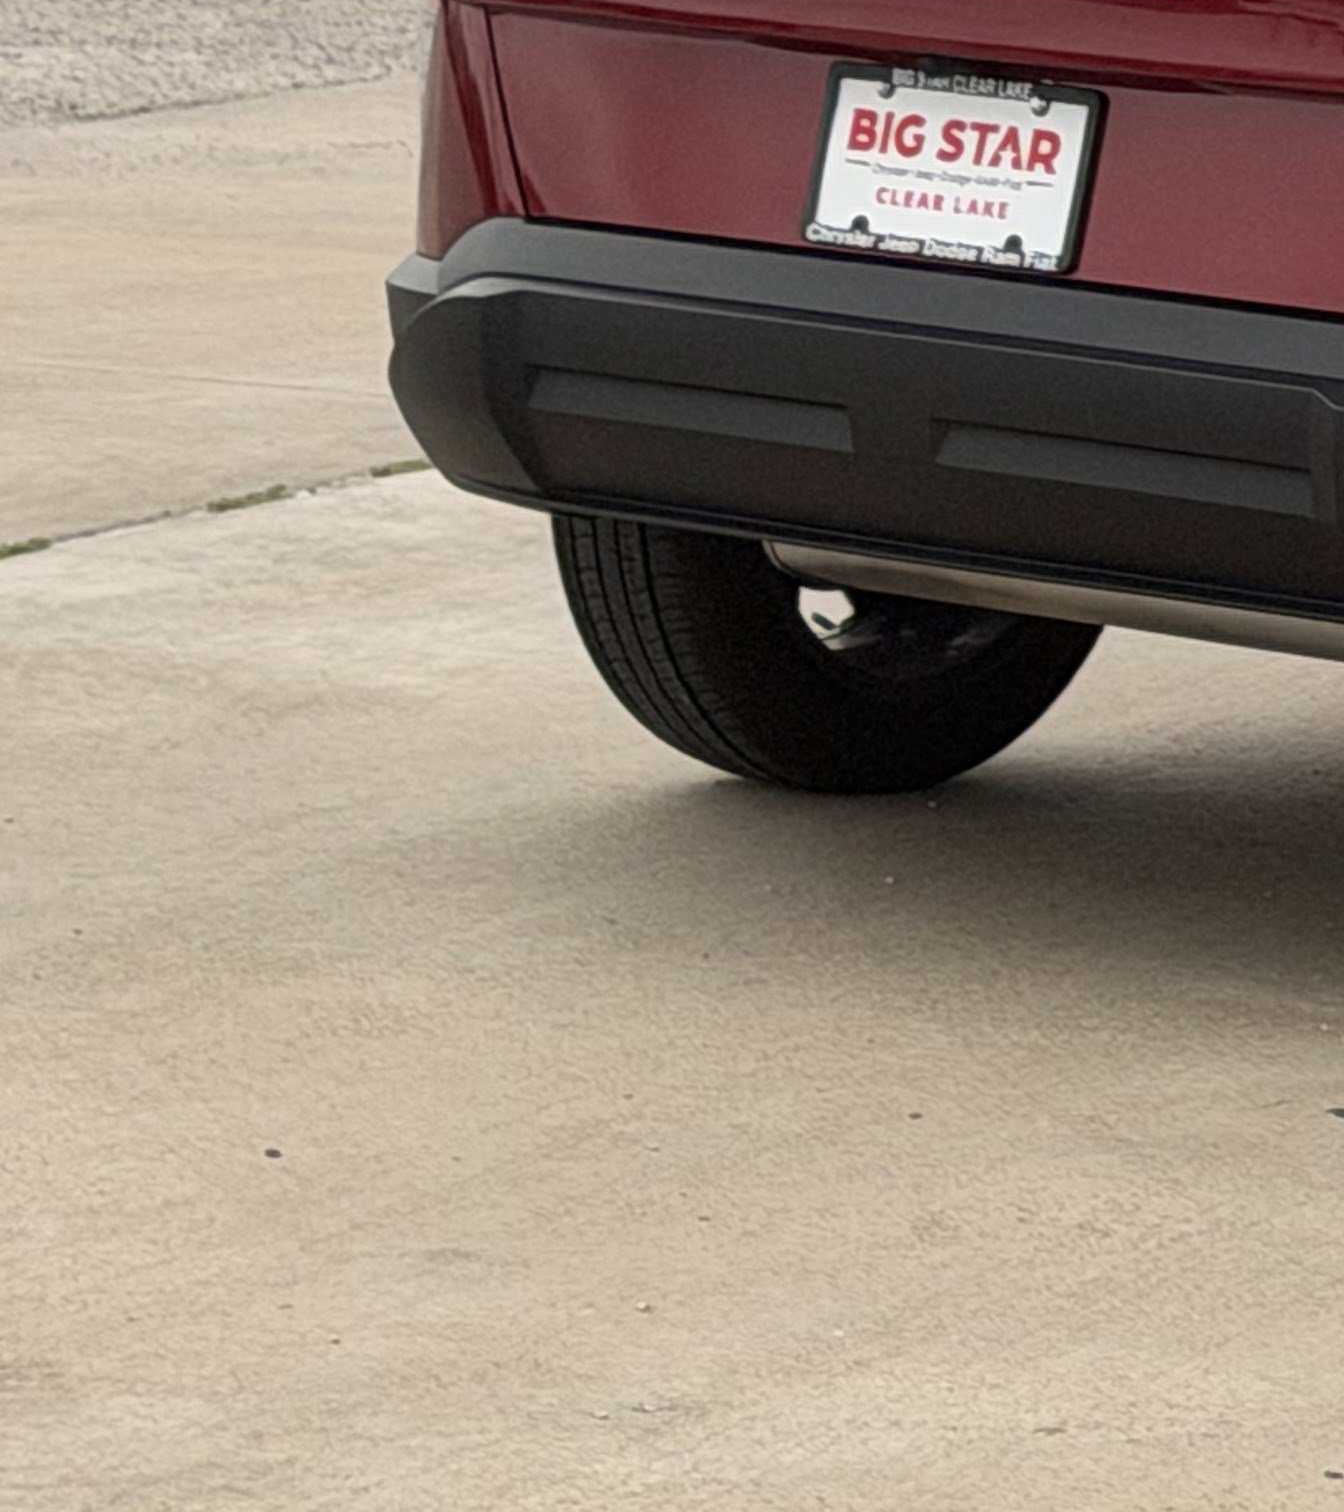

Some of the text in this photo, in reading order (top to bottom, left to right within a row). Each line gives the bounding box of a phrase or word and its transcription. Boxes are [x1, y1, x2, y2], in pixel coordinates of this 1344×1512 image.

[953, 75, 997, 94] CLEAR
[999, 79, 1034, 100] LAKE
[846, 107, 1062, 175] BIG STAR
[875, 187, 1010, 220] CLEAR LAKE
